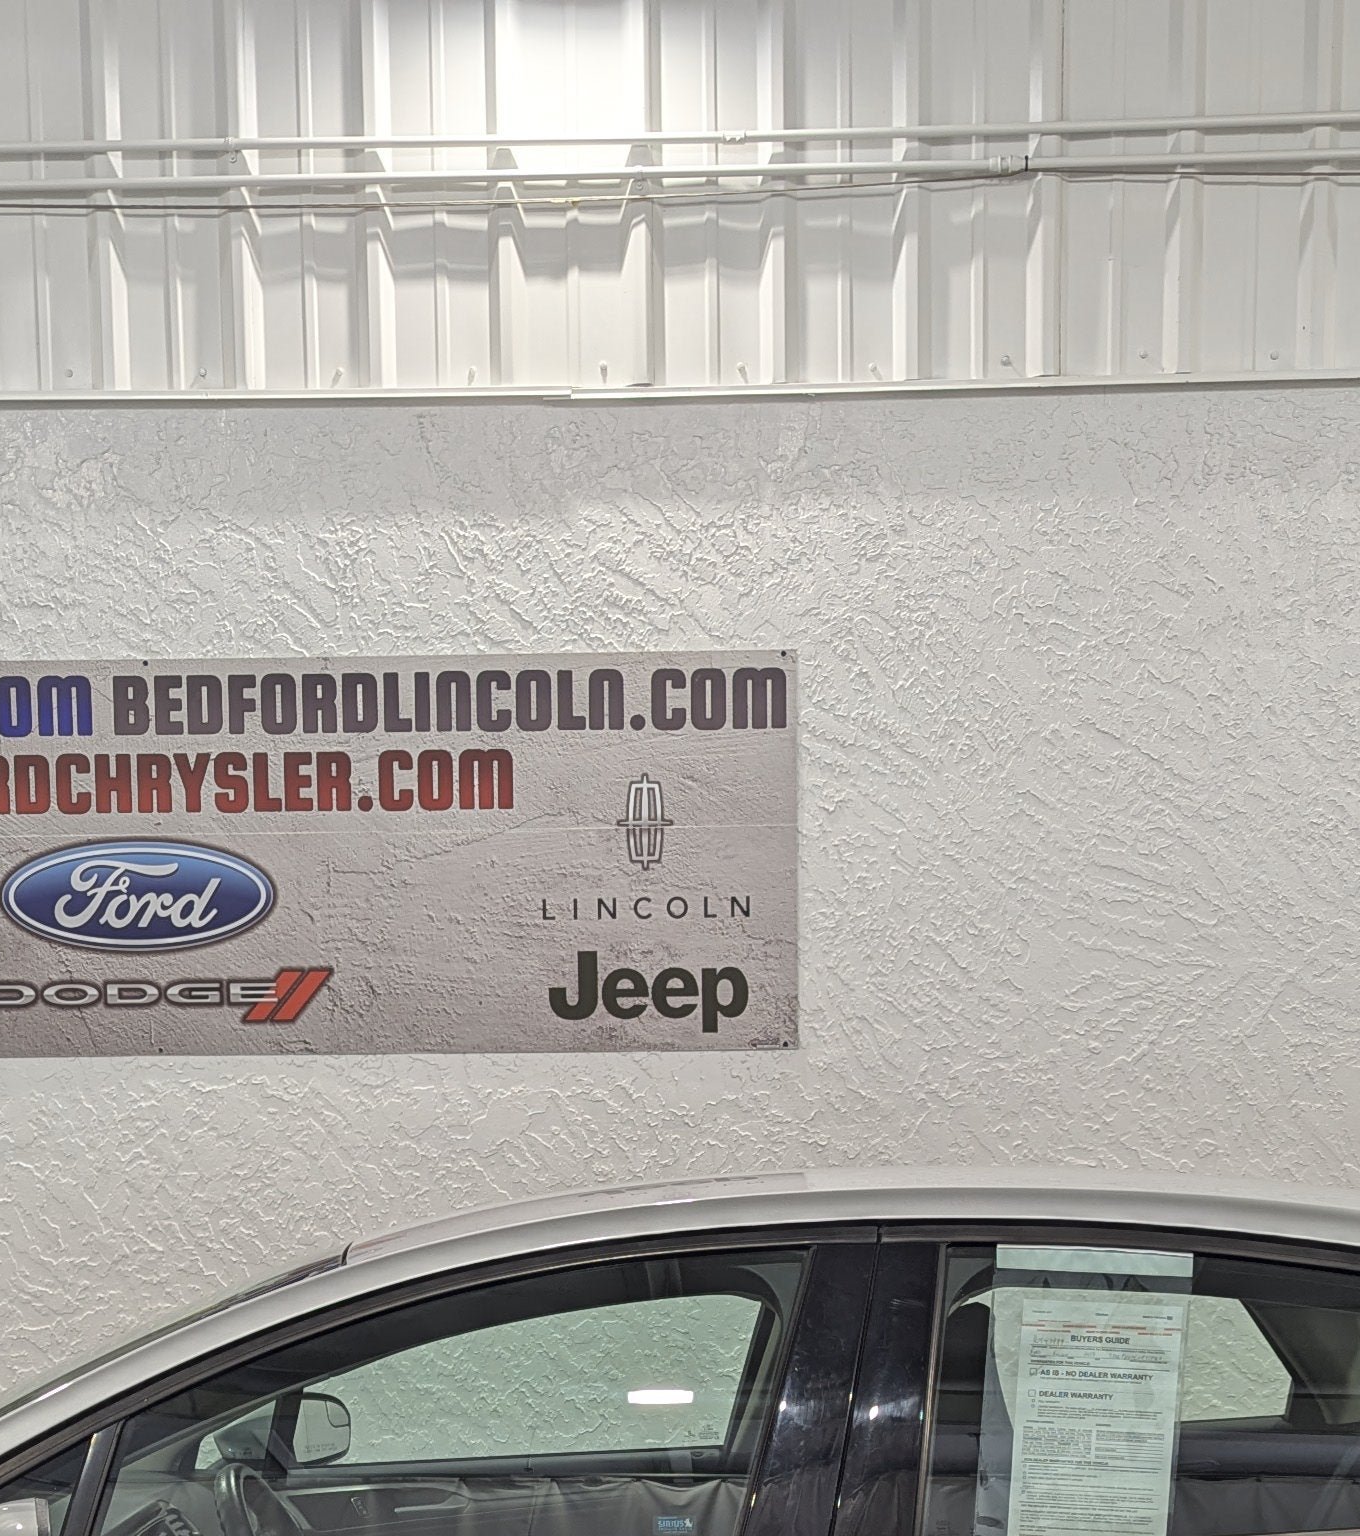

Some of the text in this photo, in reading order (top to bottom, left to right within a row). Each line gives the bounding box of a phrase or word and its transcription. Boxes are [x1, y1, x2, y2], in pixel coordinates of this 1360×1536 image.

[111, 666, 787, 736] BEDFORDLINCOLN.COM
[53, 859, 222, 929] Ford
[541, 895, 752, 921] LINCOLN
[547, 949, 748, 1033] Jeep
[1070, 1334, 1103, 1344] BUYERS
[1105, 1336, 1131, 1345] GUIDE
[1065, 1370, 1077, 1378] NO
[1078, 1371, 1109, 1379] DEALER
[1110, 1372, 1153, 1381] WARRANTY
[1038, 1390, 1114, 1401] DEALER WARRANTY
